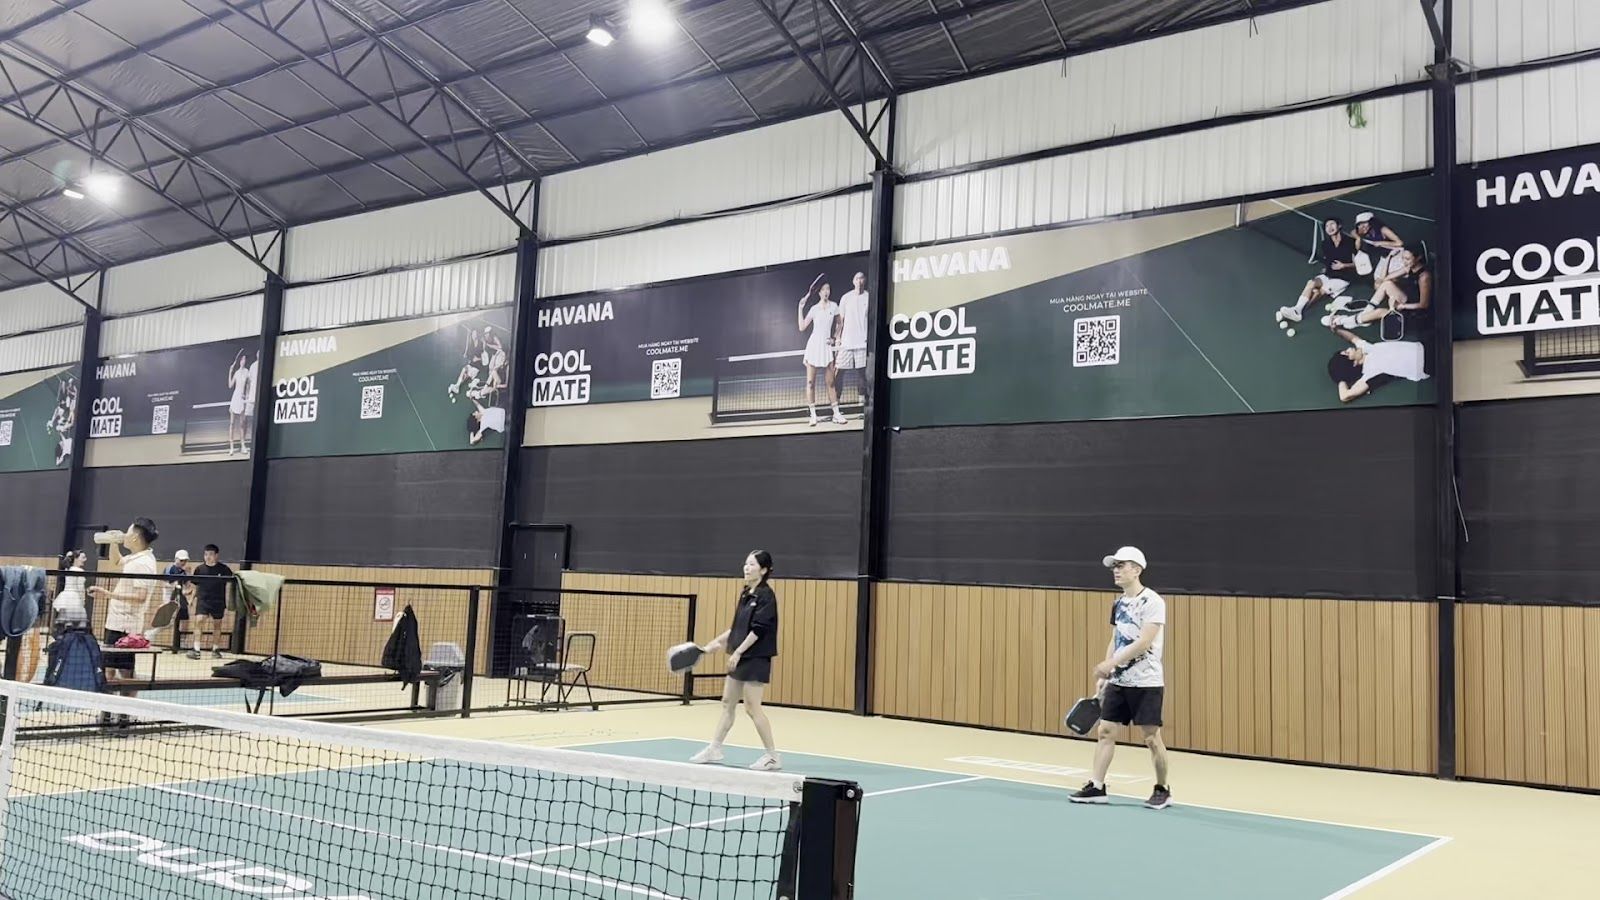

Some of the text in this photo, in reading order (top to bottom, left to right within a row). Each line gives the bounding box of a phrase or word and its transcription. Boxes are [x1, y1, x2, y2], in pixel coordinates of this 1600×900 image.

[1476, 162, 1600, 208] HAVA
[893, 246, 1011, 283] HAVANA
[1476, 236, 1600, 285] COO
[1117, 288, 1148, 297] WEBSITE
[537, 301, 614, 328] HAVANA
[1063, 298, 1131, 313] COOLMATE.ME
[1485, 284, 1600, 328] MAT
[889, 307, 977, 341] COOL
[280, 336, 338, 357] HAVANA
[892, 343, 971, 373] MATE
[96, 362, 137, 380] HAVANA
[534, 350, 592, 375] COOL
[276, 376, 319, 397] COOL
[536, 378, 587, 402] MATE
[92, 397, 123, 415] COOL
[276, 400, 315, 420] MATE
[92, 417, 121, 435] MATE
